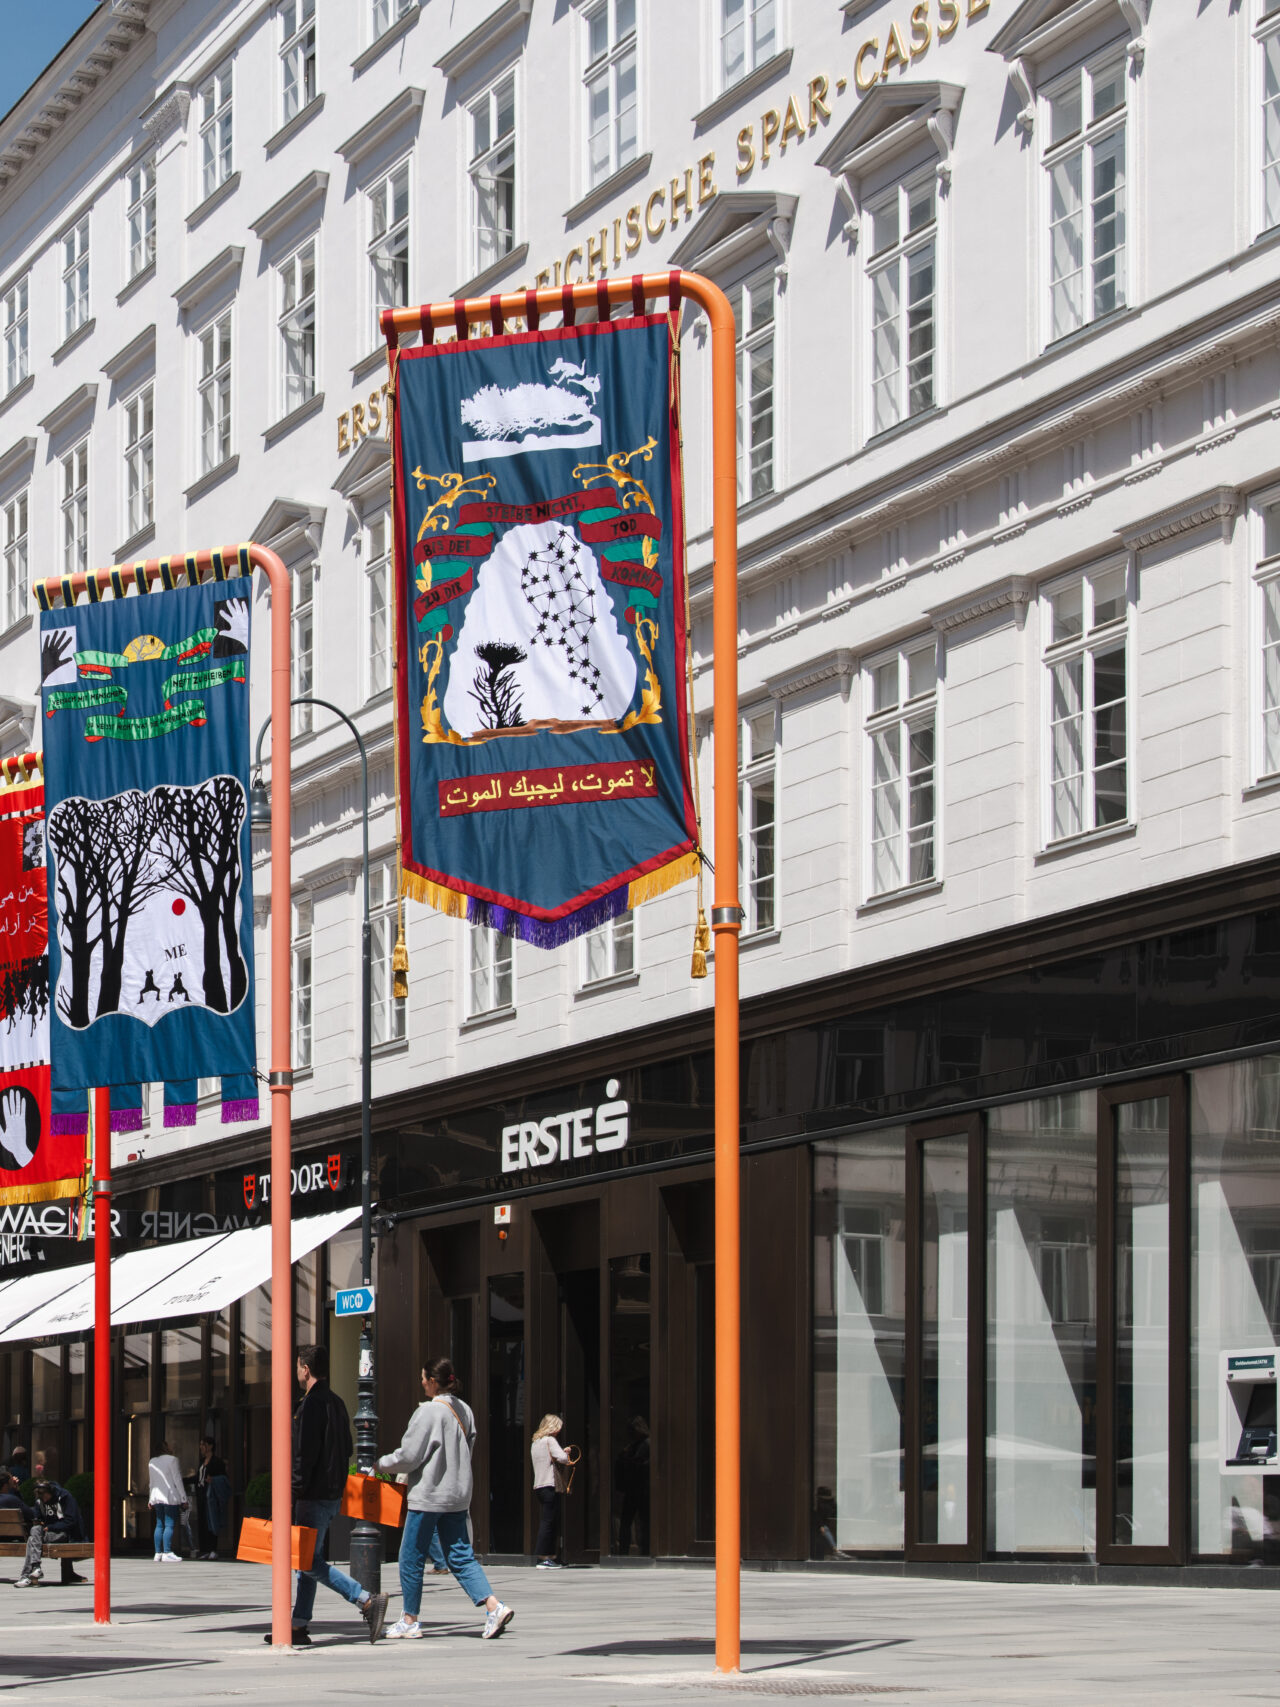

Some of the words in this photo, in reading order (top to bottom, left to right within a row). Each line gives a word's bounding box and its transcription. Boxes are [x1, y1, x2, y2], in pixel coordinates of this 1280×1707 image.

[337, 382, 389, 453] ERS
[610, 519, 638, 536] TOD
[423, 538, 444, 557] BIS
[610, 565, 661, 588] KOMMT
[423, 591, 441, 609] ZU
[444, 580, 464, 599] DIR
[172, 677, 191, 688] NETT
[203, 668, 232, 682] BLEIBEN
[639, 765, 655, 787] لا
[17, 884, 34, 903] من
[23, 915, 36, 933] در
[164, 943, 188, 962] ME
[501, 1107, 593, 1174] ERSTE
[259, 1162, 324, 1202] TOR
[341, 1294, 355, 1311] WC
